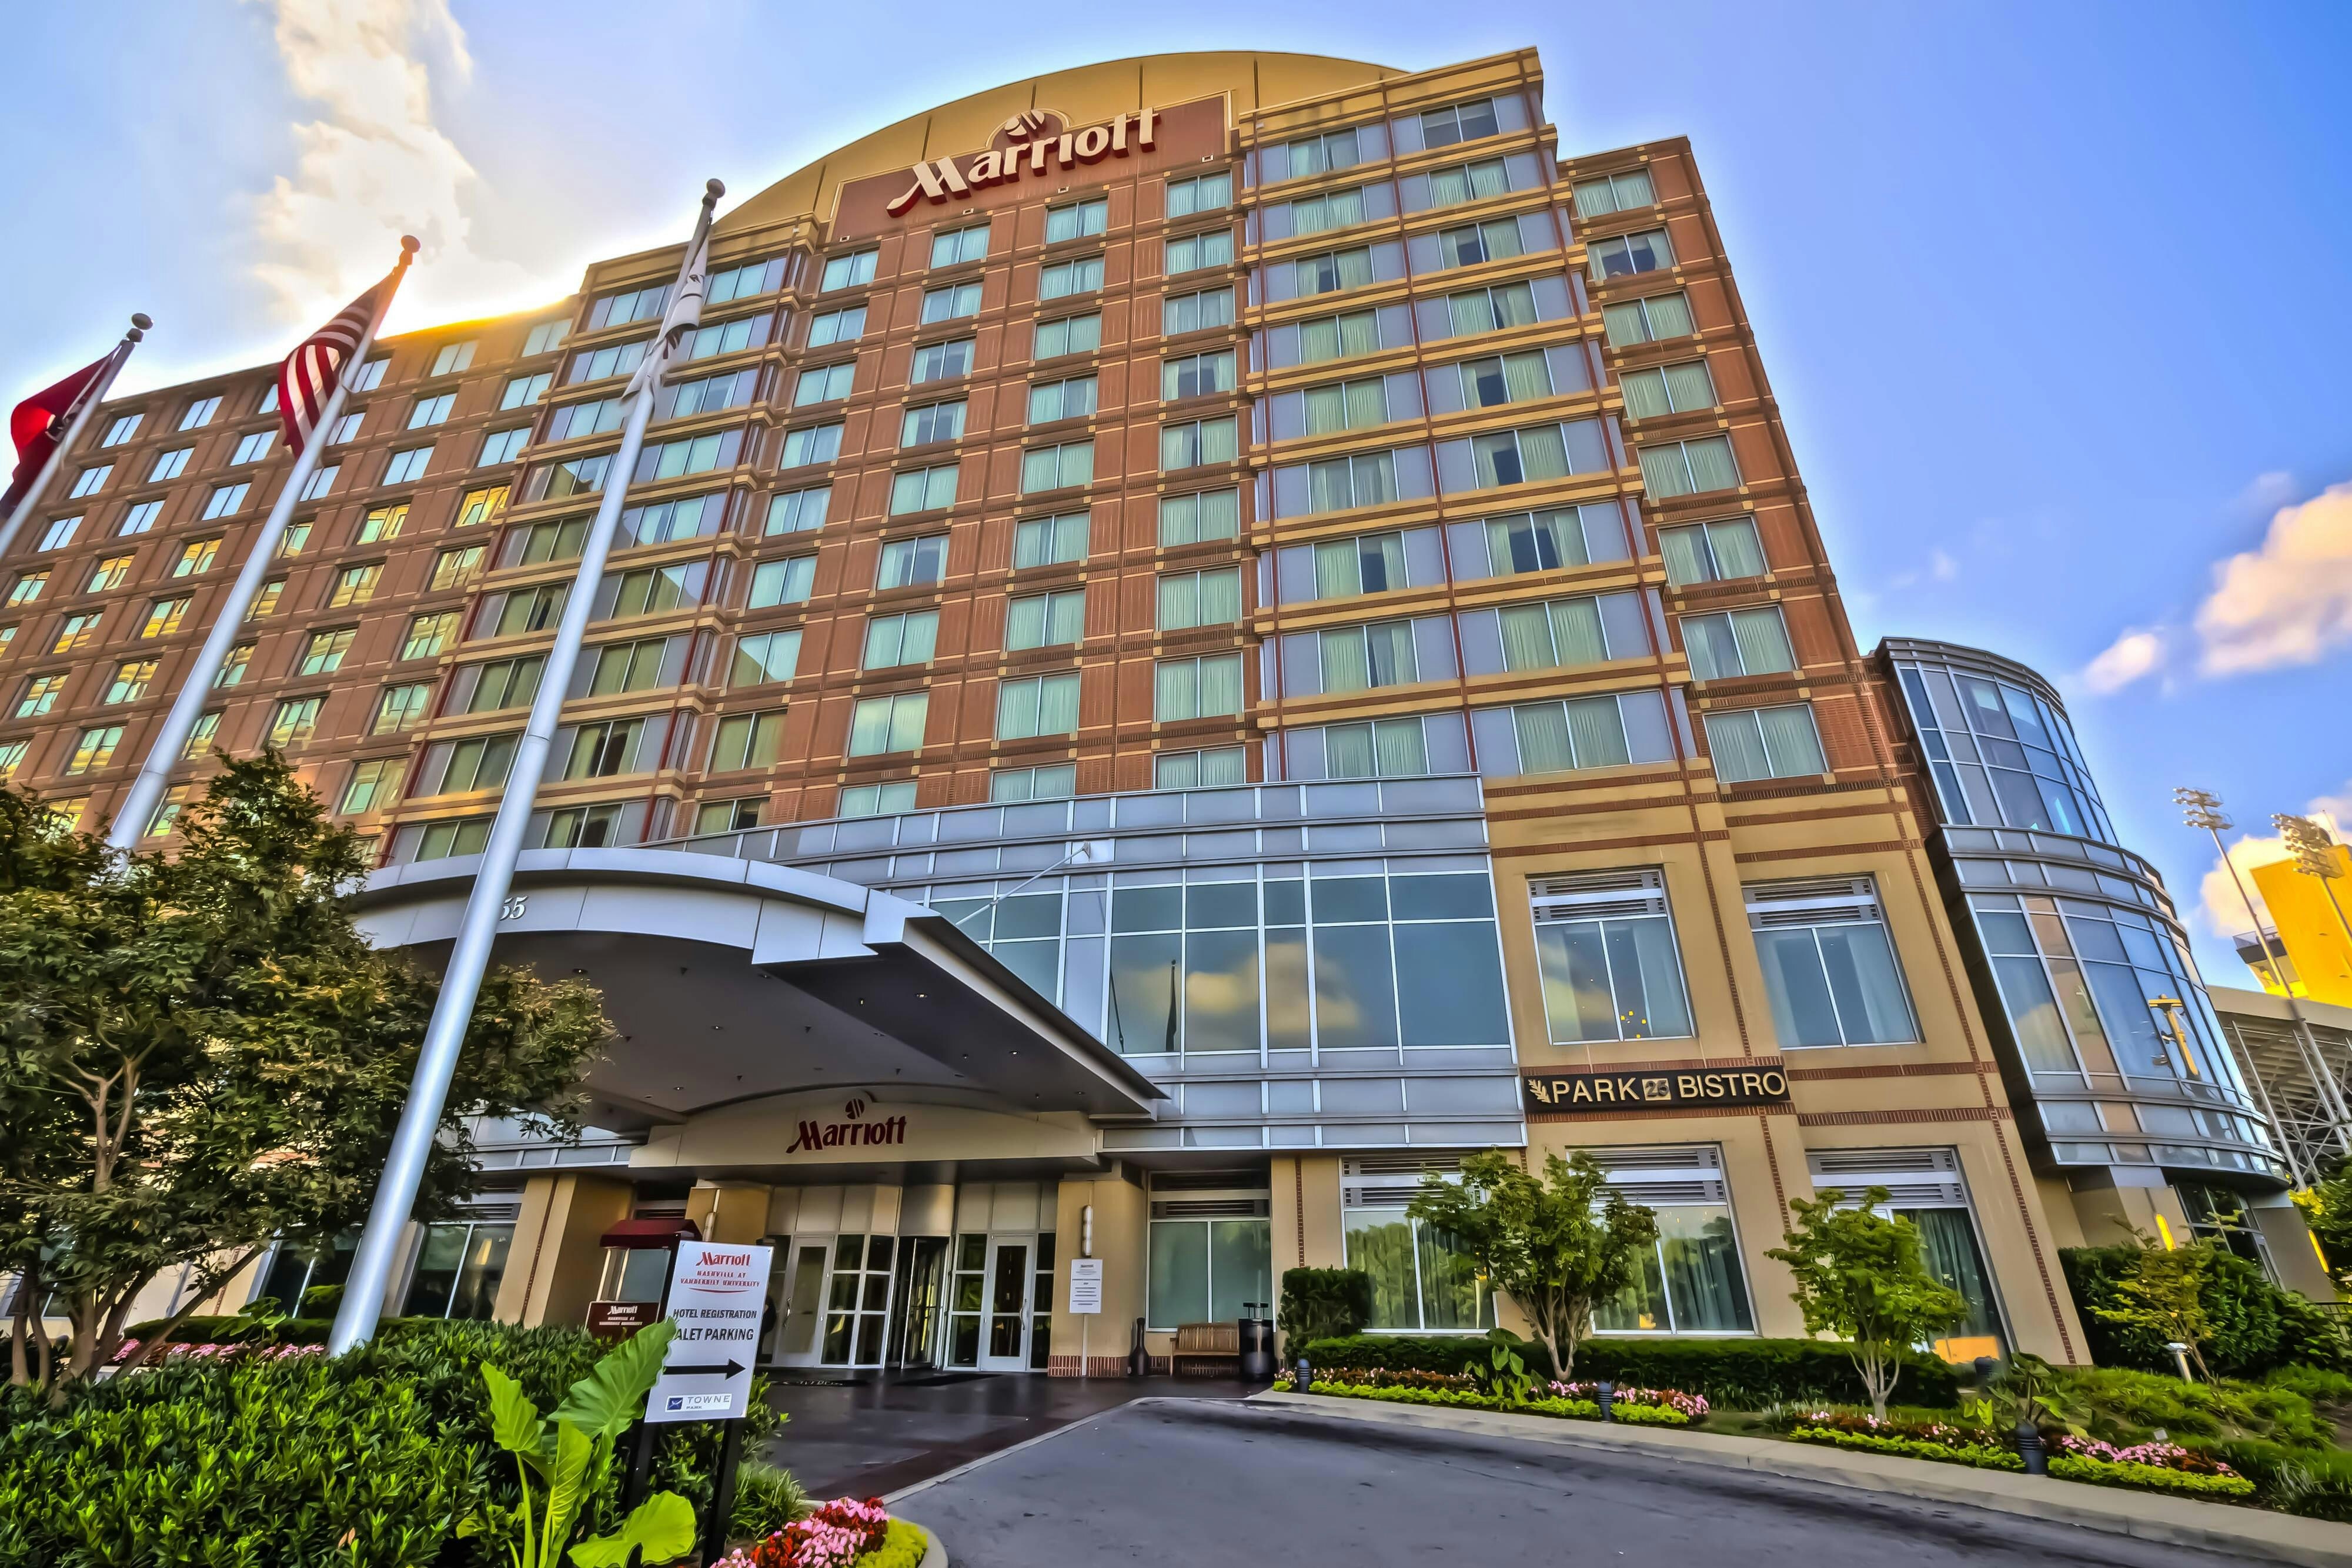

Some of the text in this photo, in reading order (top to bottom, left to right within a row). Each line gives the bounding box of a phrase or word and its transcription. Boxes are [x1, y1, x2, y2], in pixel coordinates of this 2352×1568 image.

[886, 107, 1161, 218] Marriott
[1552, 1071, 1786, 1104] PARK 25 BISTRO
[786, 1116, 907, 1154] Marriott
[696, 1251, 751, 1266] Marriott
[673, 1309, 757, 1319] HOTEL REGISTRATION
[674, 1328, 754, 1340] ALET PARKING
[687, 1395, 731, 1404] TOWNE
